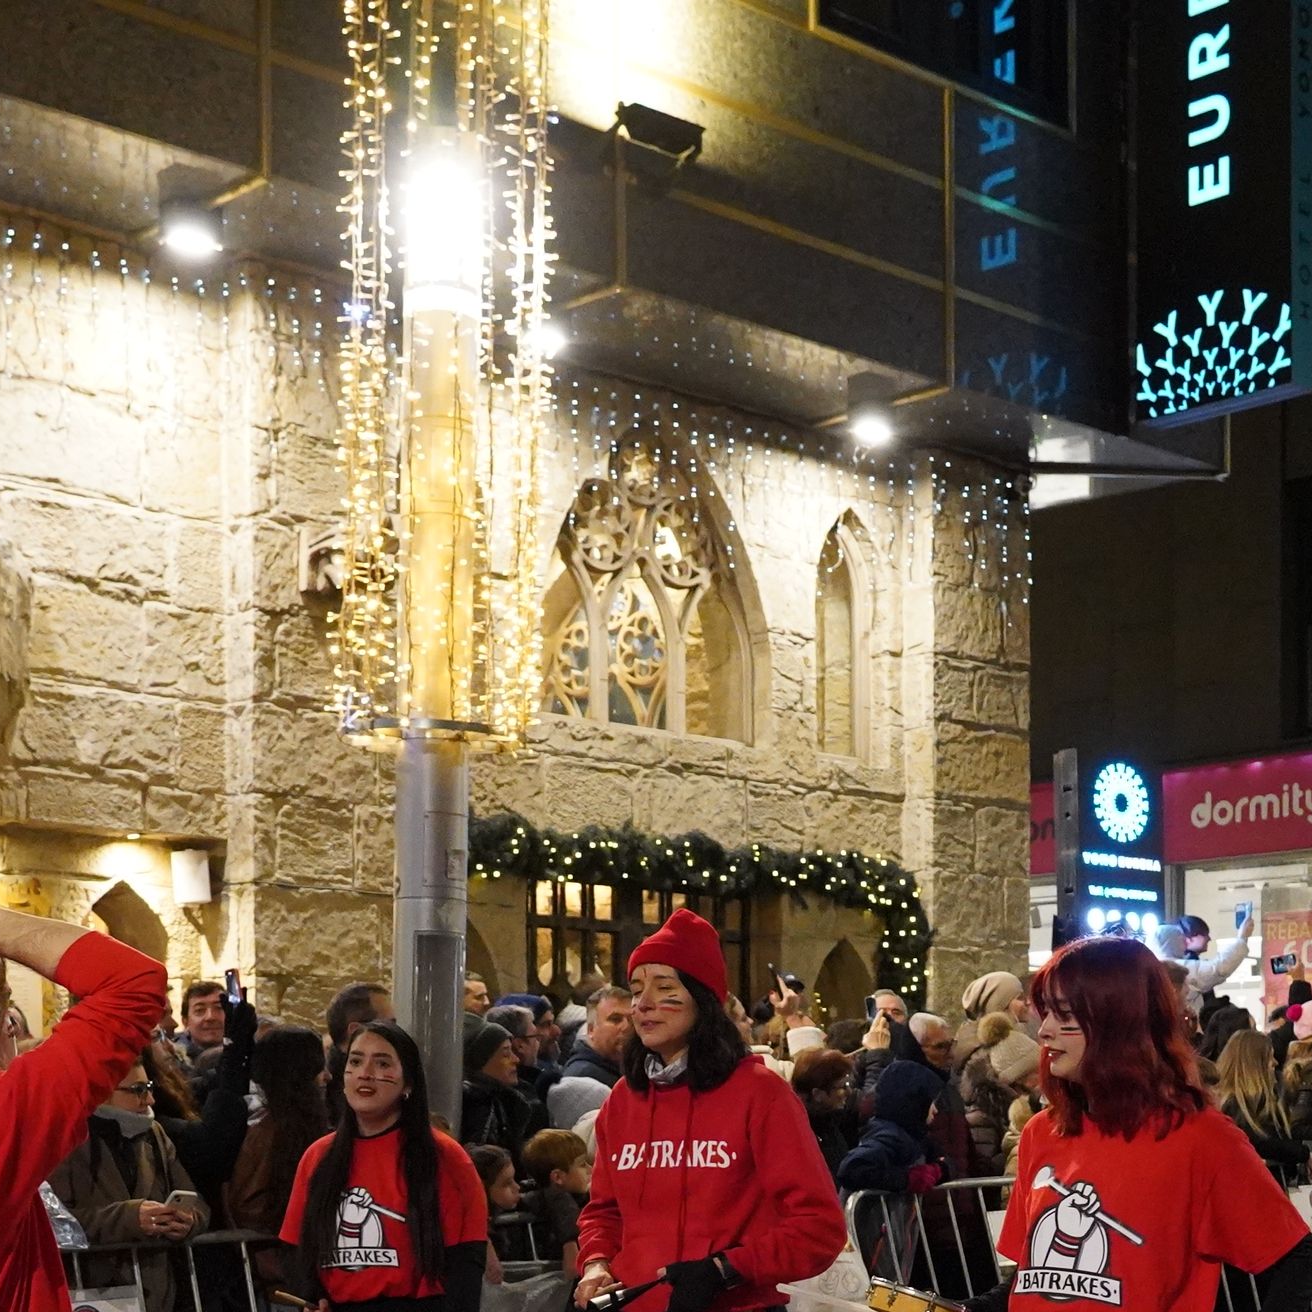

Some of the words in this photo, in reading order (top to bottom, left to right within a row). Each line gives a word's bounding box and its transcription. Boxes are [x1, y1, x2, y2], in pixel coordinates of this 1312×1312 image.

[617, 1140, 730, 1171] BATRAKES
[328, 1248, 393, 1264] ATRAKES
[1022, 1271, 1112, 1299] BATRAKES
